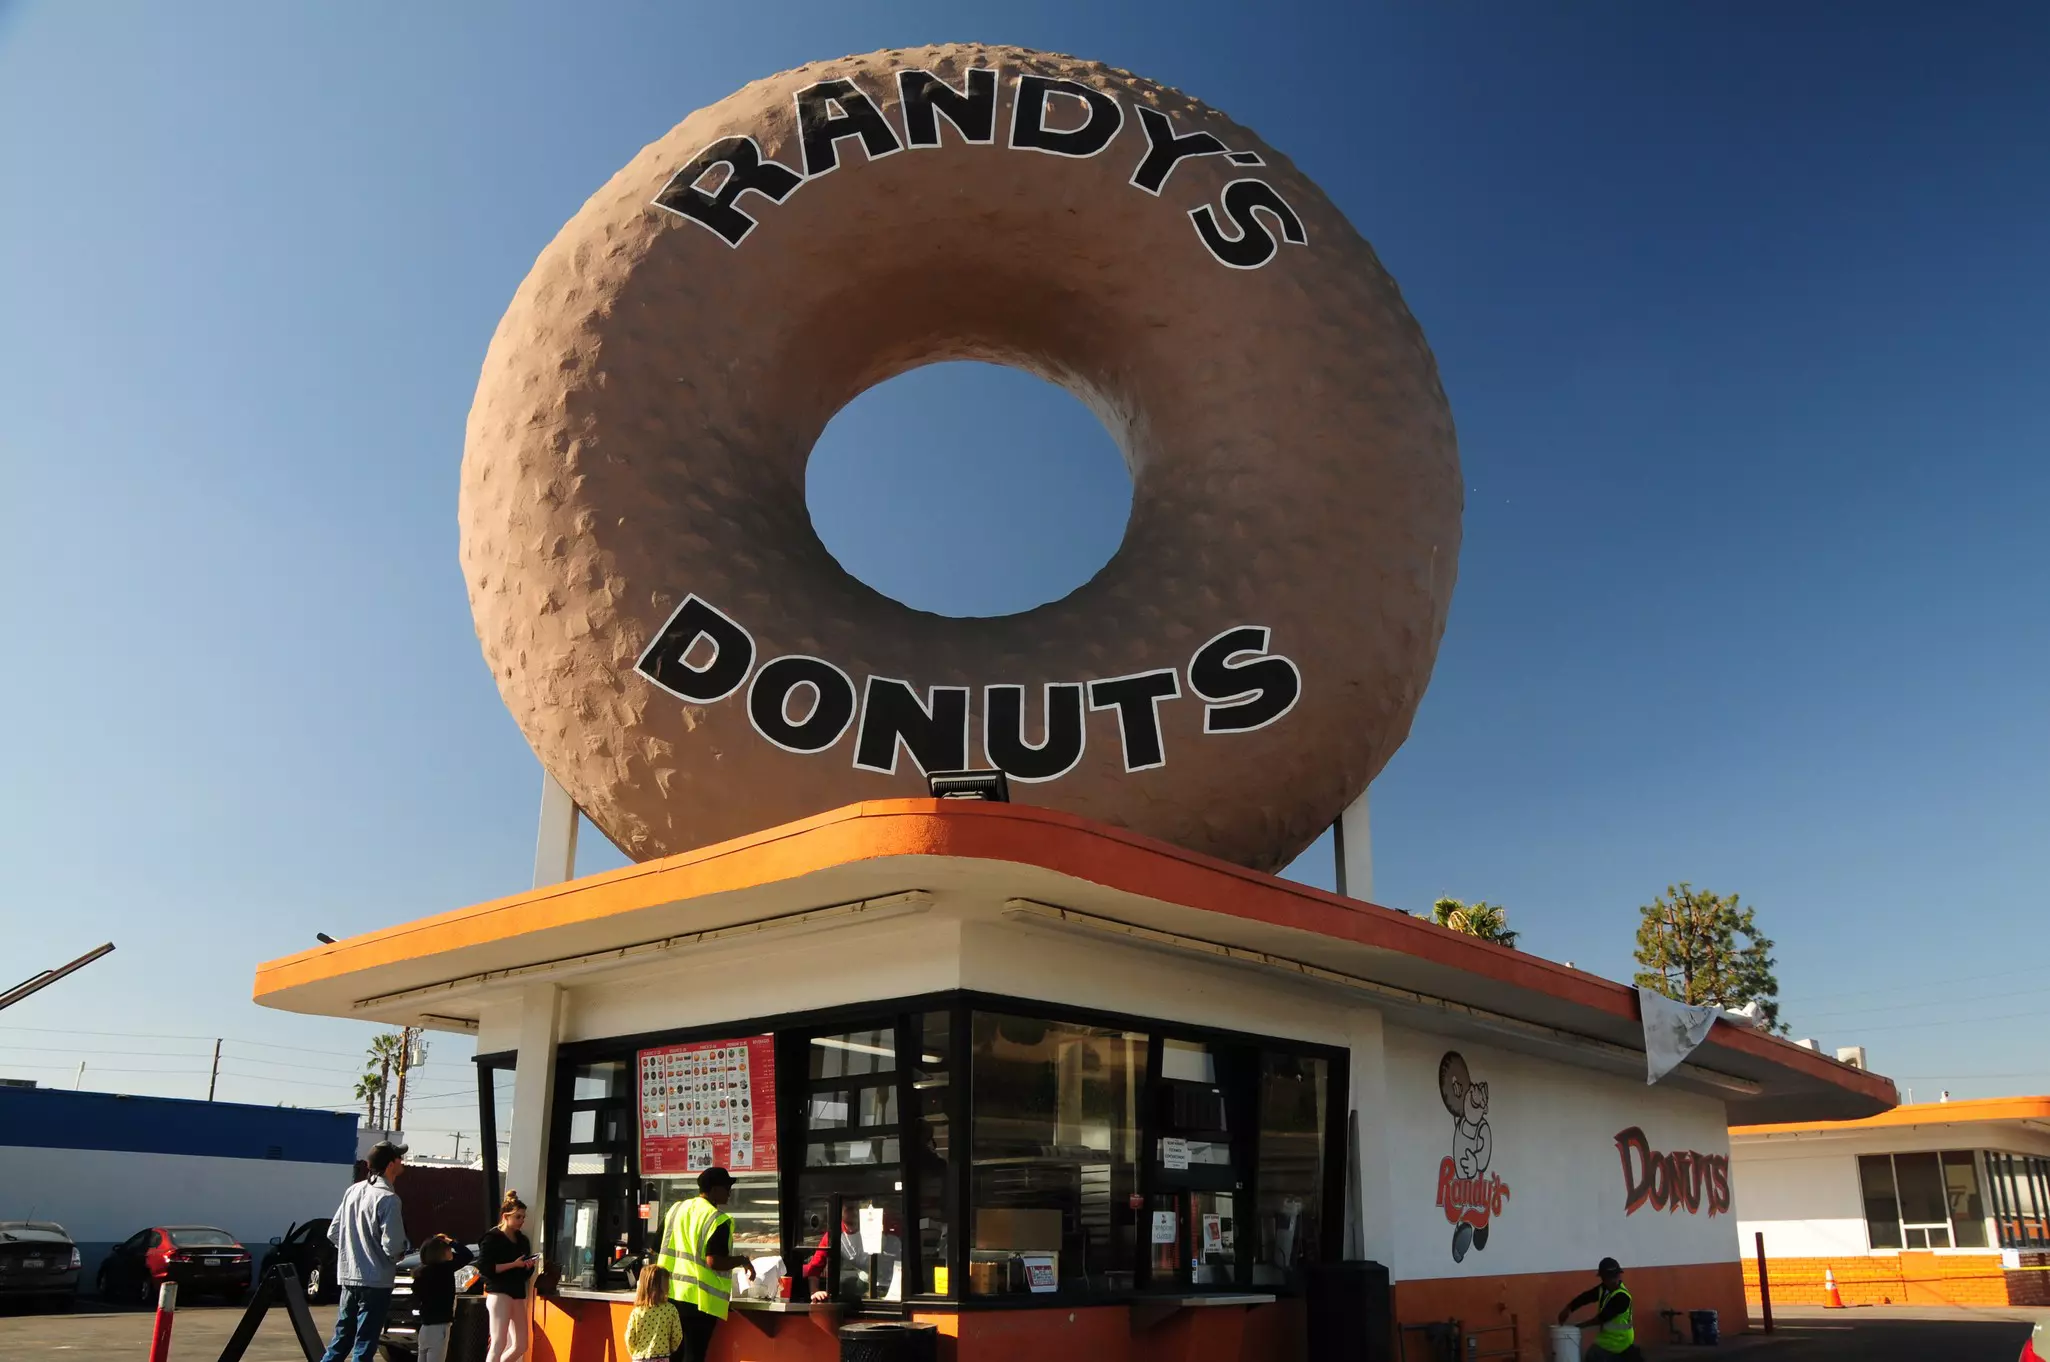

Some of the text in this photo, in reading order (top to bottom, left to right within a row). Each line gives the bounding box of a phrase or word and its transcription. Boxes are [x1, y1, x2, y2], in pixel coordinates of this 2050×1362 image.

[649, 67, 1308, 270] RANDY'S
[633, 592, 1301, 784] DONUTS
[1435, 1155, 1510, 1229] Randy's
[1613, 1125, 1730, 1219] DONUTS
